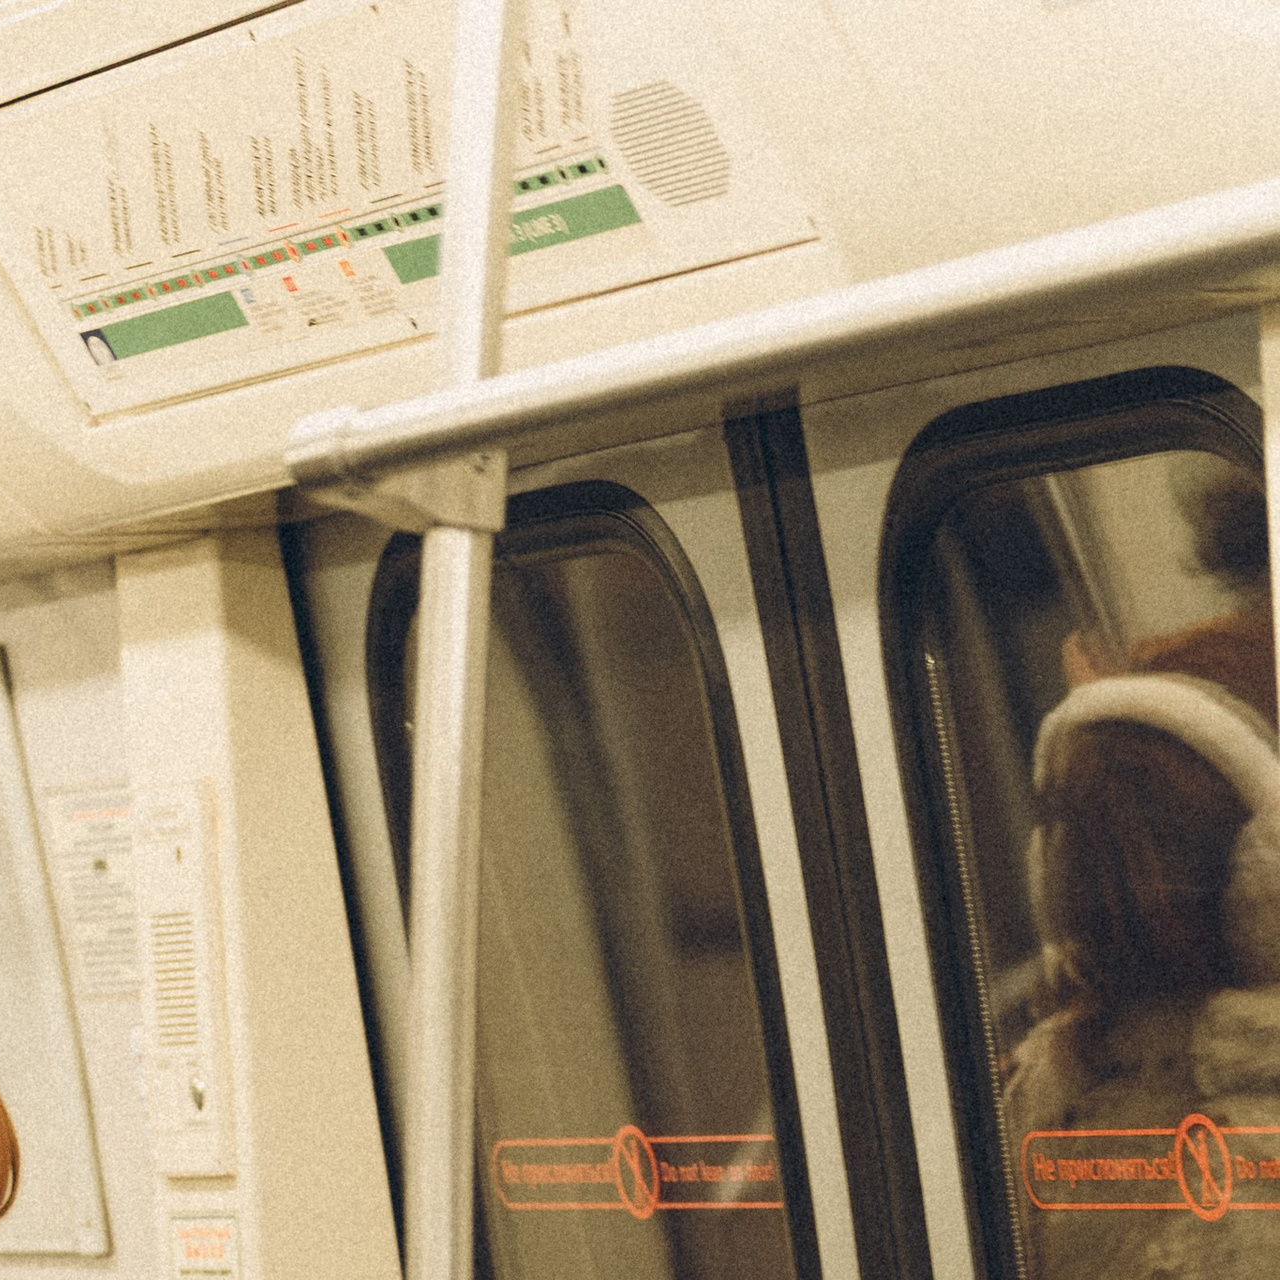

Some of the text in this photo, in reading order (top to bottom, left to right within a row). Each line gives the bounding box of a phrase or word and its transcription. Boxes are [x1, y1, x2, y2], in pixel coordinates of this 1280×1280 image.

[659, 1161, 678, 1183] Do
[678, 1162, 699, 1183] not
[698, 1157, 724, 1183] lean
[1032, 1153, 1056, 1181] Не
[1235, 1155, 1257, 1180] Do
